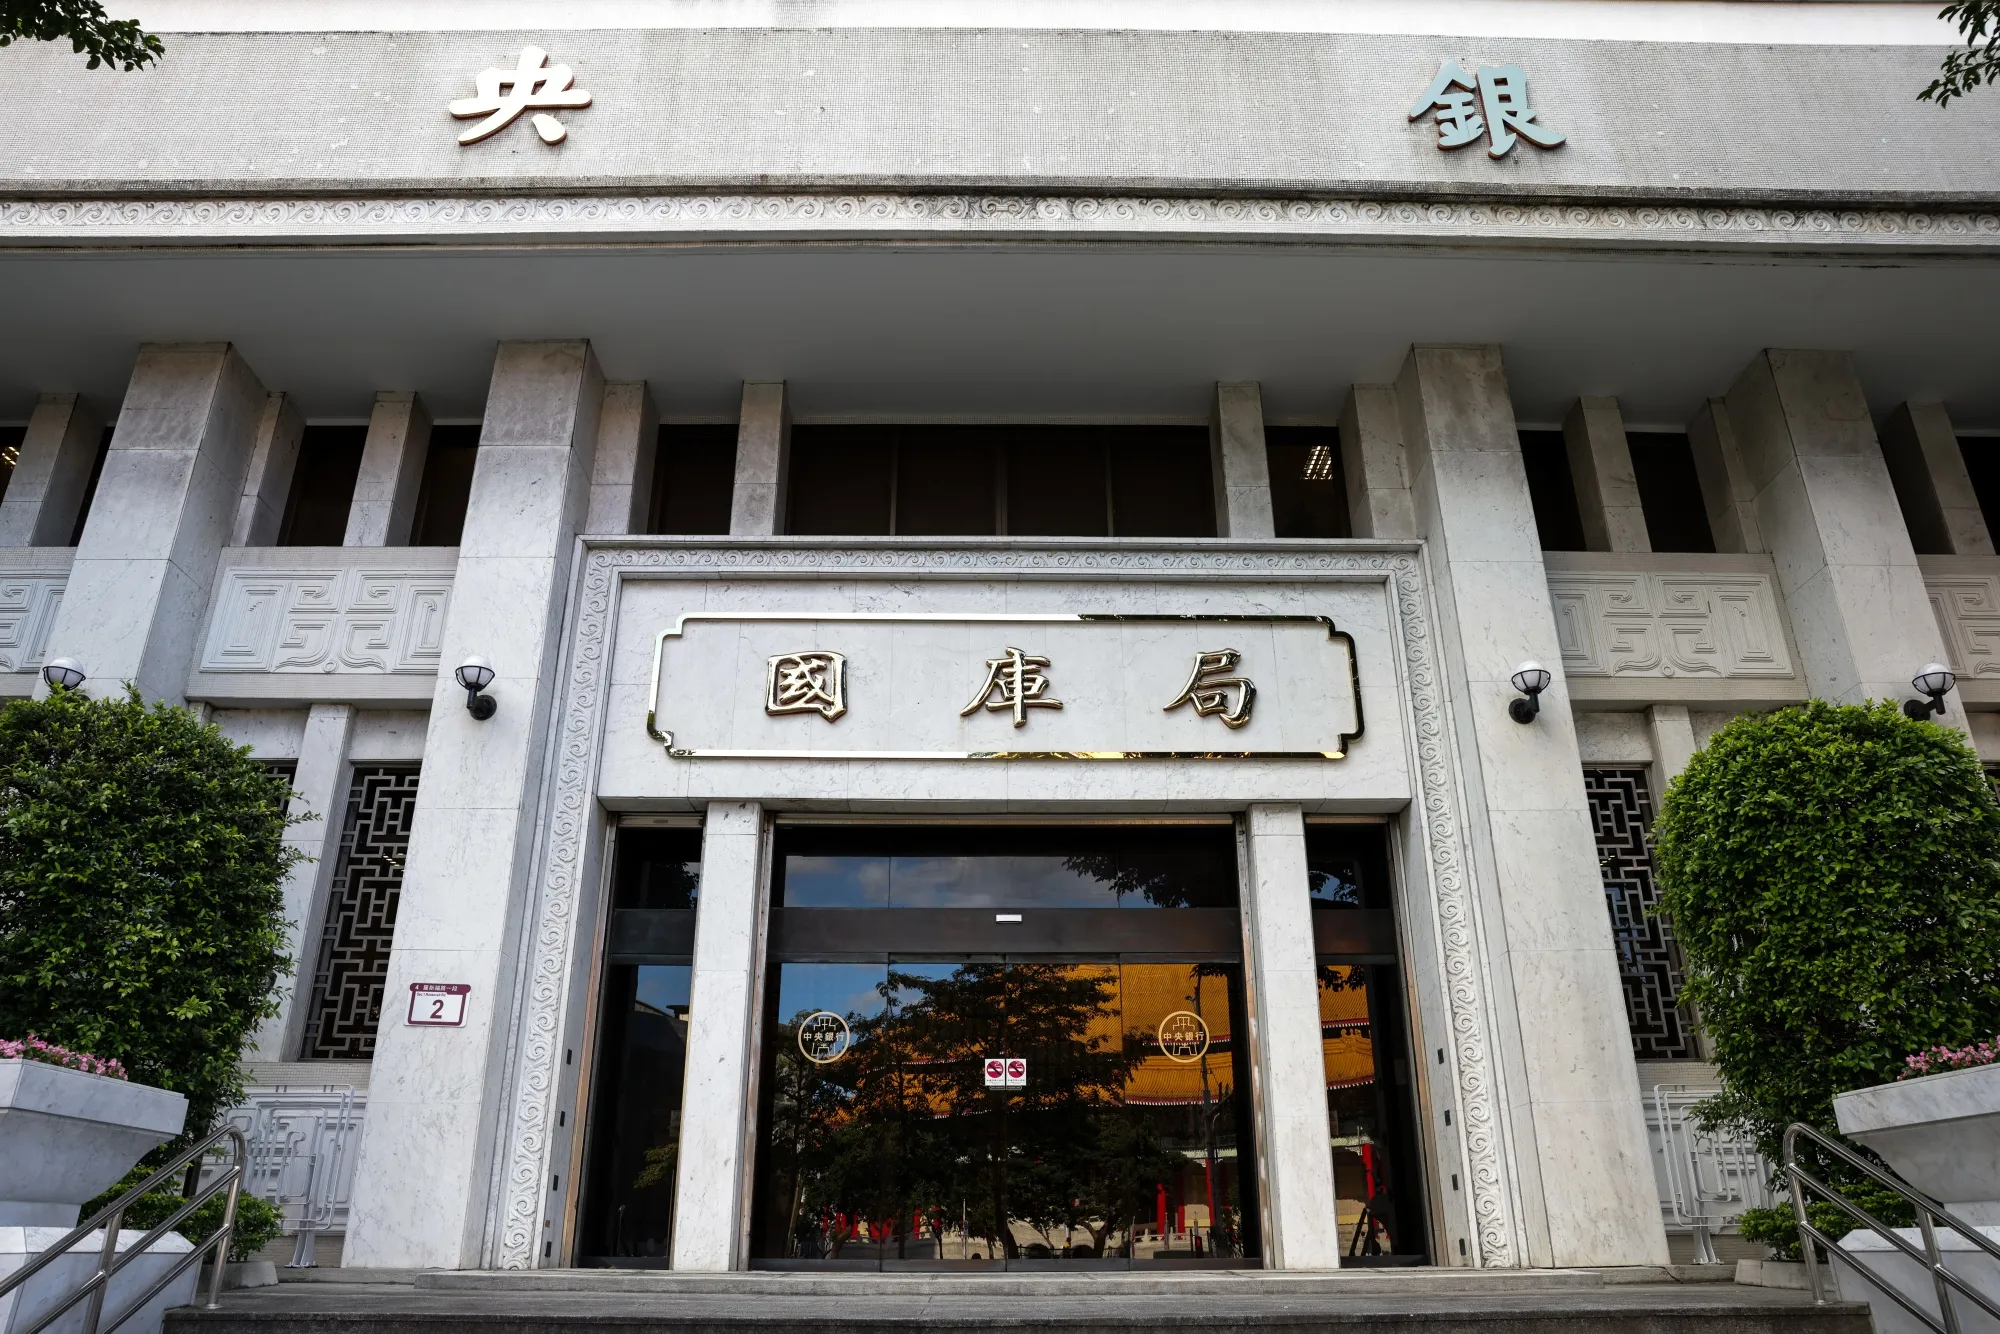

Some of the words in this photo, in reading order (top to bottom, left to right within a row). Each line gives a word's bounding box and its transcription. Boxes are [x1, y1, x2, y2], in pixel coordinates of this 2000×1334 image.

[449, 45, 592, 146] 央
[1408, 60, 1566, 158] 銀
[766, 648, 1257, 728] 國庫局
[430, 999, 444, 1019] 2
[803, 1032, 845, 1041] 中央銀行
[1163, 1031, 1205, 1041] 中央銀行
